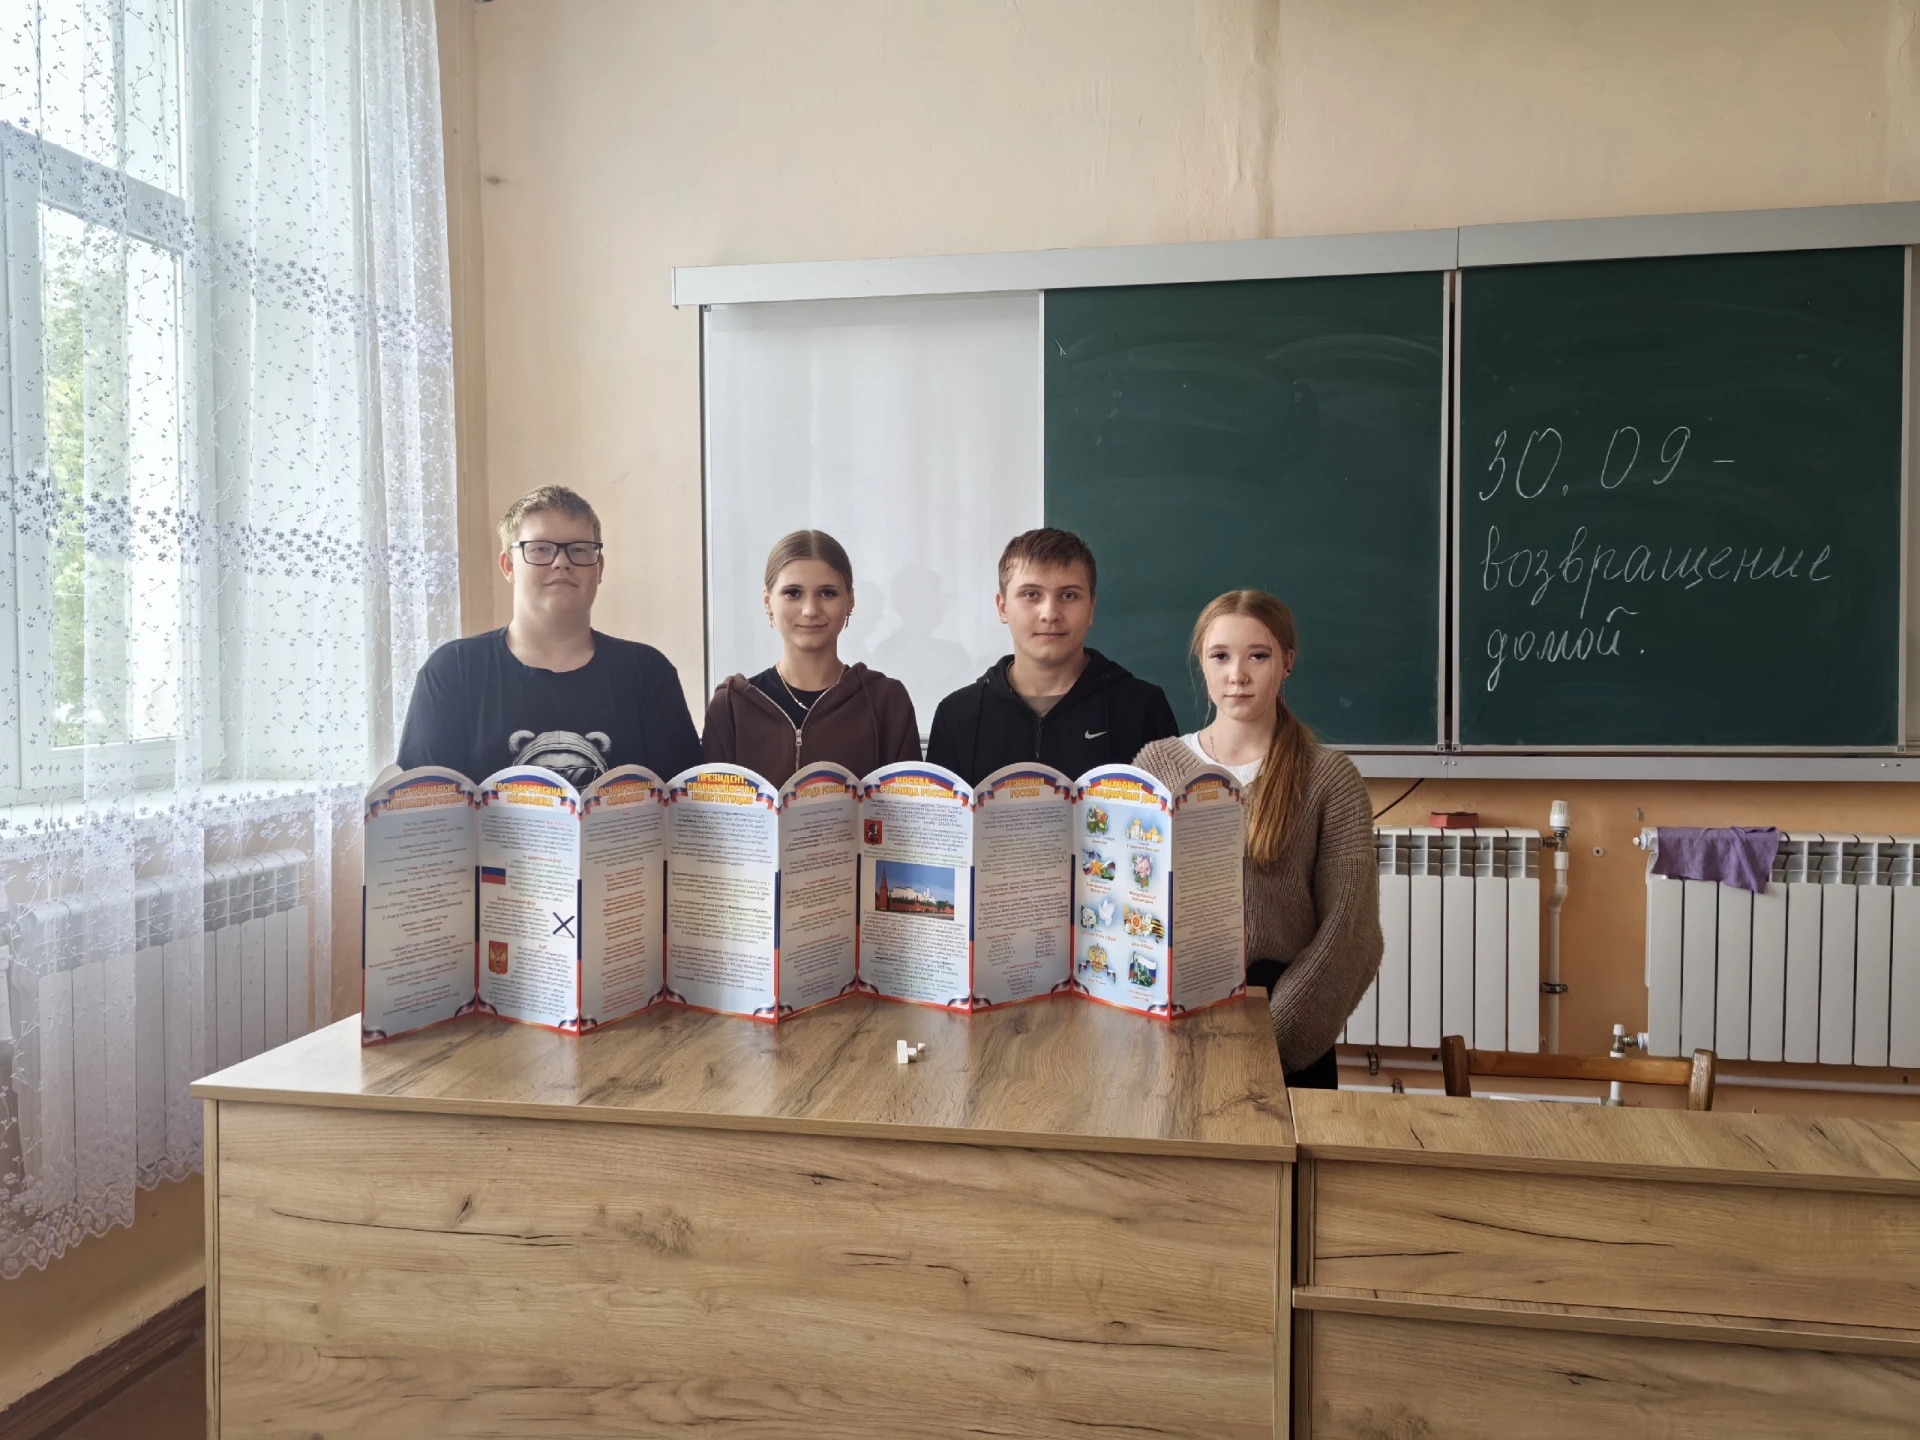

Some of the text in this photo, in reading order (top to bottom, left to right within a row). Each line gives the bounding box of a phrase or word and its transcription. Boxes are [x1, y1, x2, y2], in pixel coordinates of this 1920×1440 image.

[1480, 525, 1832, 619] возвращение
[1487, 606, 1645, 692] домой.
[821, 782, 846, 795] РОССИИ
[895, 776, 930, 787] МОСКВА
[1101, 779, 1143, 791] ВЫХОДНЫЕ
[394, 783, 458, 799] ИСТОРИЧЕСКИЕ
[493, 782, 567, 797] ГОСУДАРСТВЕННАЯ
[880, 785, 955, 799] СТОЛИЦА РОССИИ
[1009, 787, 1040, 798] РОССИИ
[432, 793, 465, 806] РОССИИ
[506, 793, 554, 807] СИМВОЛИКА
